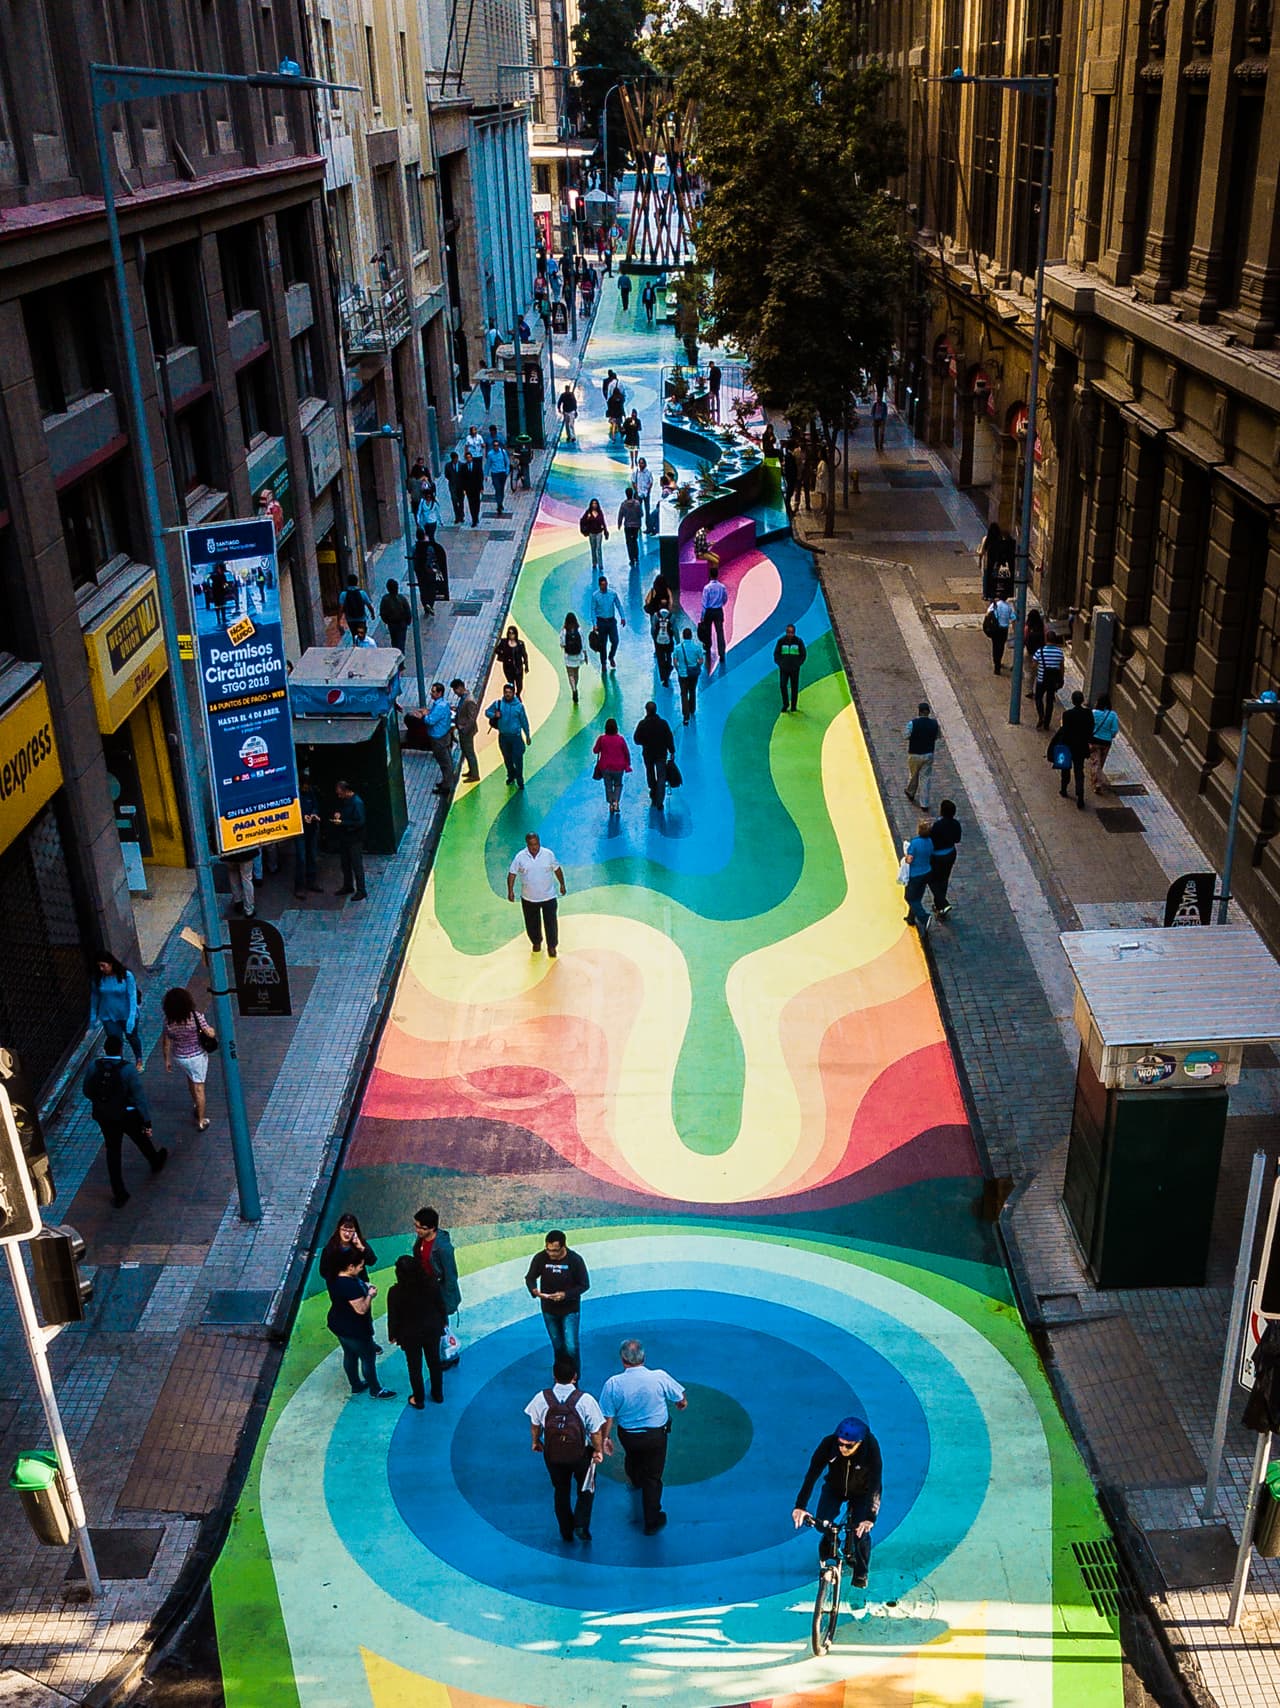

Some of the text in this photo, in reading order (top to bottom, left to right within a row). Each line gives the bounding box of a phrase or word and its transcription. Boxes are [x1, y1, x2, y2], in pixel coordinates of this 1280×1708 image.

[107, 611, 137, 652] WESTERN
[119, 628, 140, 659] UNION
[210, 643, 274, 665] Permisos
[205, 656, 282, 683] Circulación
[222, 675, 270, 694] STGO 2018
[217, 699, 242, 710] PUNTOS
[242, 697, 251, 705] DE
[250, 694, 268, 704] PAGO
[218, 715, 239, 727] HASTA
[240, 714, 247, 722] EL
[253, 710, 262, 719] DE
[247, 757, 254, 767] 3
[227, 809, 238, 818] SIN
[237, 806, 253, 815] FILAS
[257, 803, 267, 811] EN
[266, 797, 292, 809] MINUTOS
[243, 970, 280, 985] PASEO
[1138, 1068, 1159, 1077] WOM
